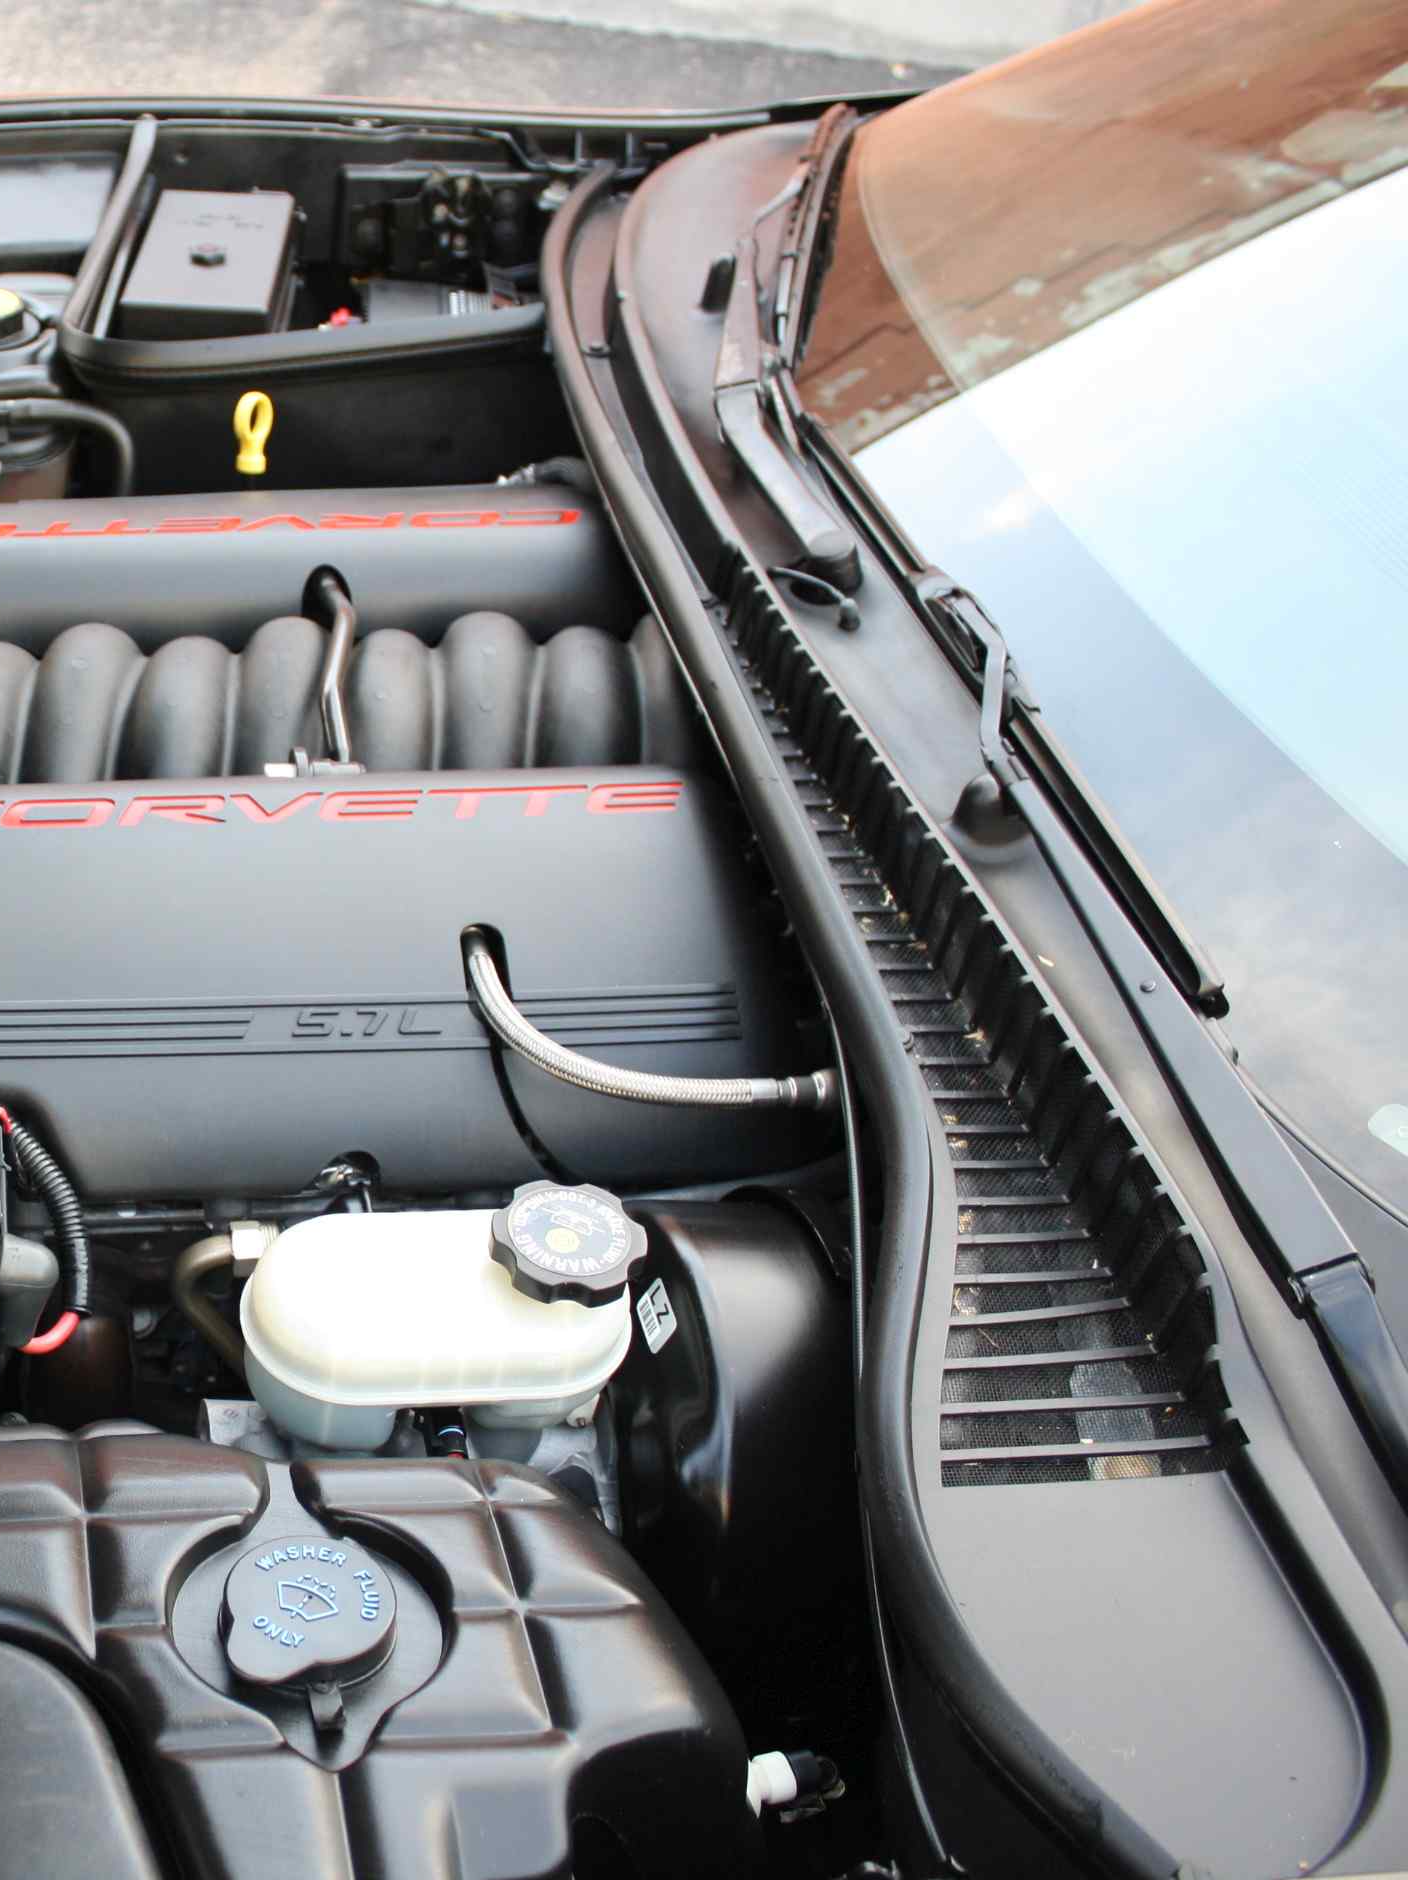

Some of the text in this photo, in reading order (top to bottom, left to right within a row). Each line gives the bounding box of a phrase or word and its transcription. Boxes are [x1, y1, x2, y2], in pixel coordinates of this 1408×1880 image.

[289, 1009, 445, 1038] 5.7L
[516, 1236, 601, 1273] WARNING
[255, 1543, 381, 1621] WASHER FLUID
[251, 1614, 306, 1648] ONLY
